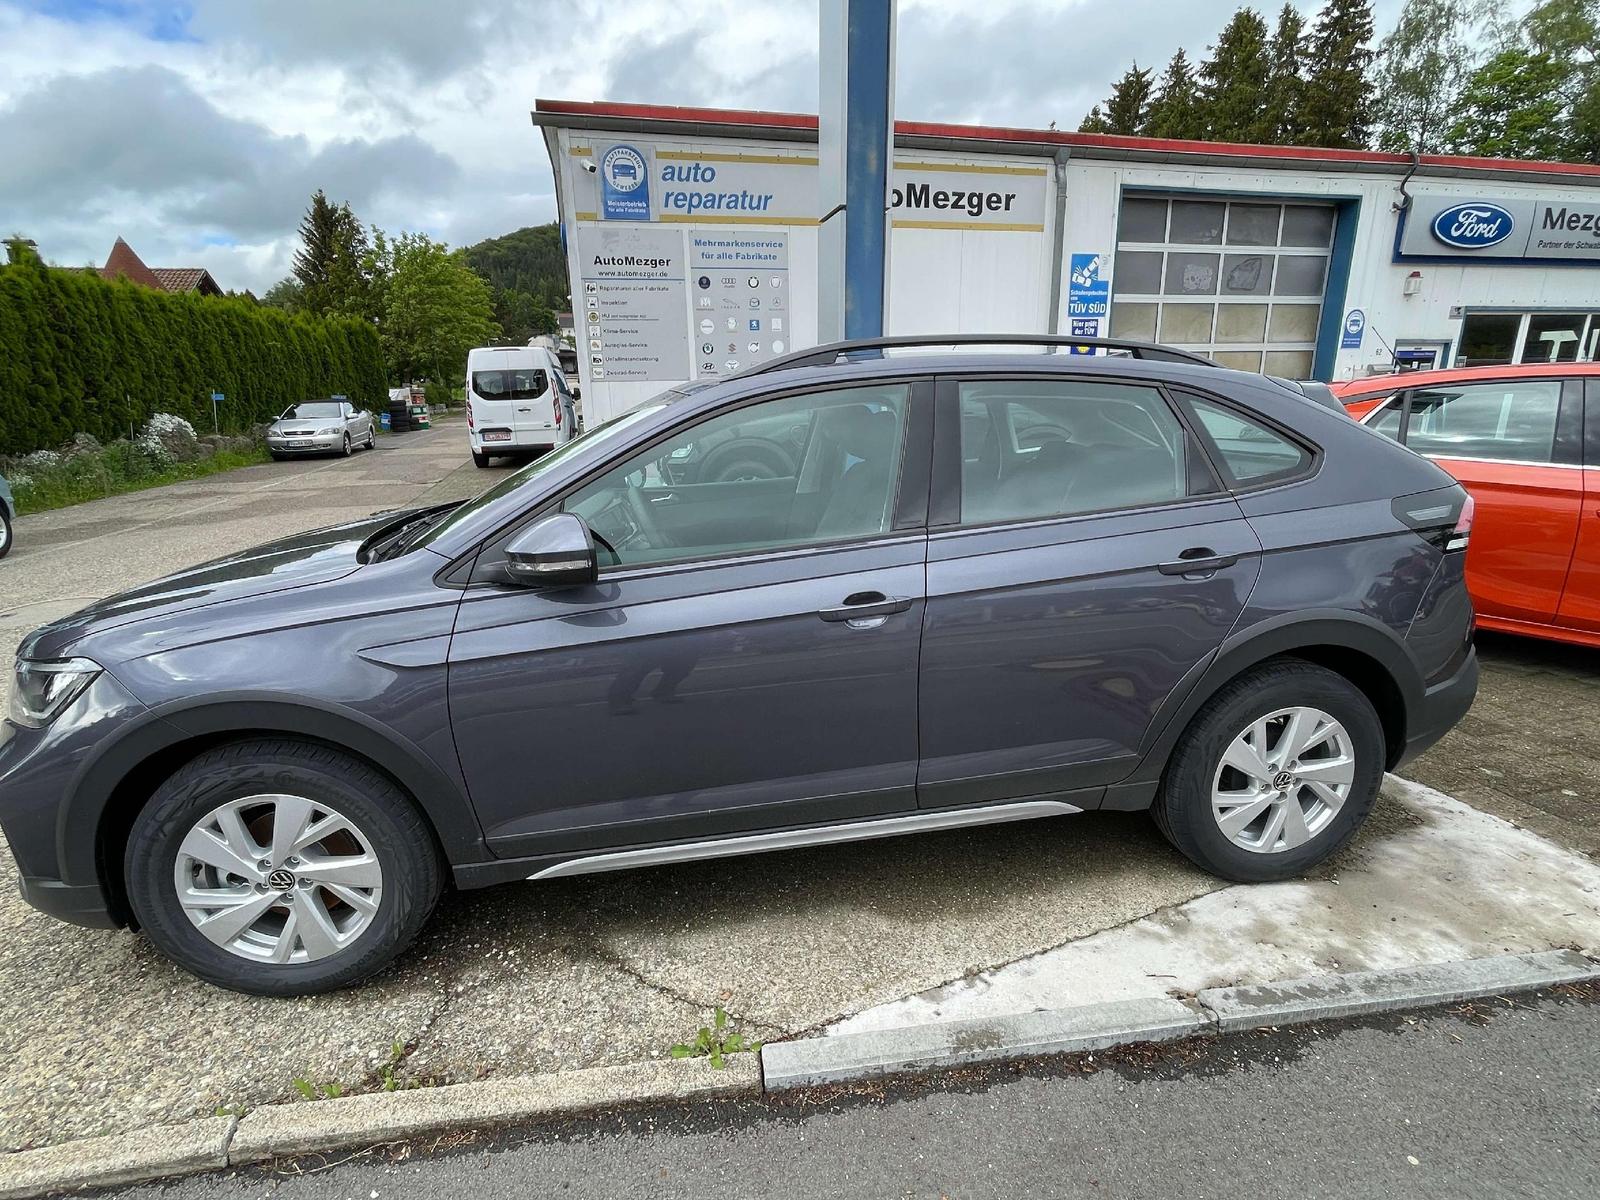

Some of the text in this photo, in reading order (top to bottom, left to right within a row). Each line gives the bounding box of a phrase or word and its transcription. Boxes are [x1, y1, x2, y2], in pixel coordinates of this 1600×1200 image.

[661, 163, 716, 182] auto
[664, 190, 773, 214] reparatur
[1451, 209, 1502, 238] Ford
[694, 240, 784, 249] Mehrmarkenservice
[1537, 240, 1563, 249] Partner
[1563, 241, 1576, 249] der
[701, 252, 778, 261] für alle Fabrikate
[593, 256, 671, 269] AutoMezger
[598, 270, 668, 279] www.automezger.de
[1070, 302, 1106, 313] TÜV SÜD
